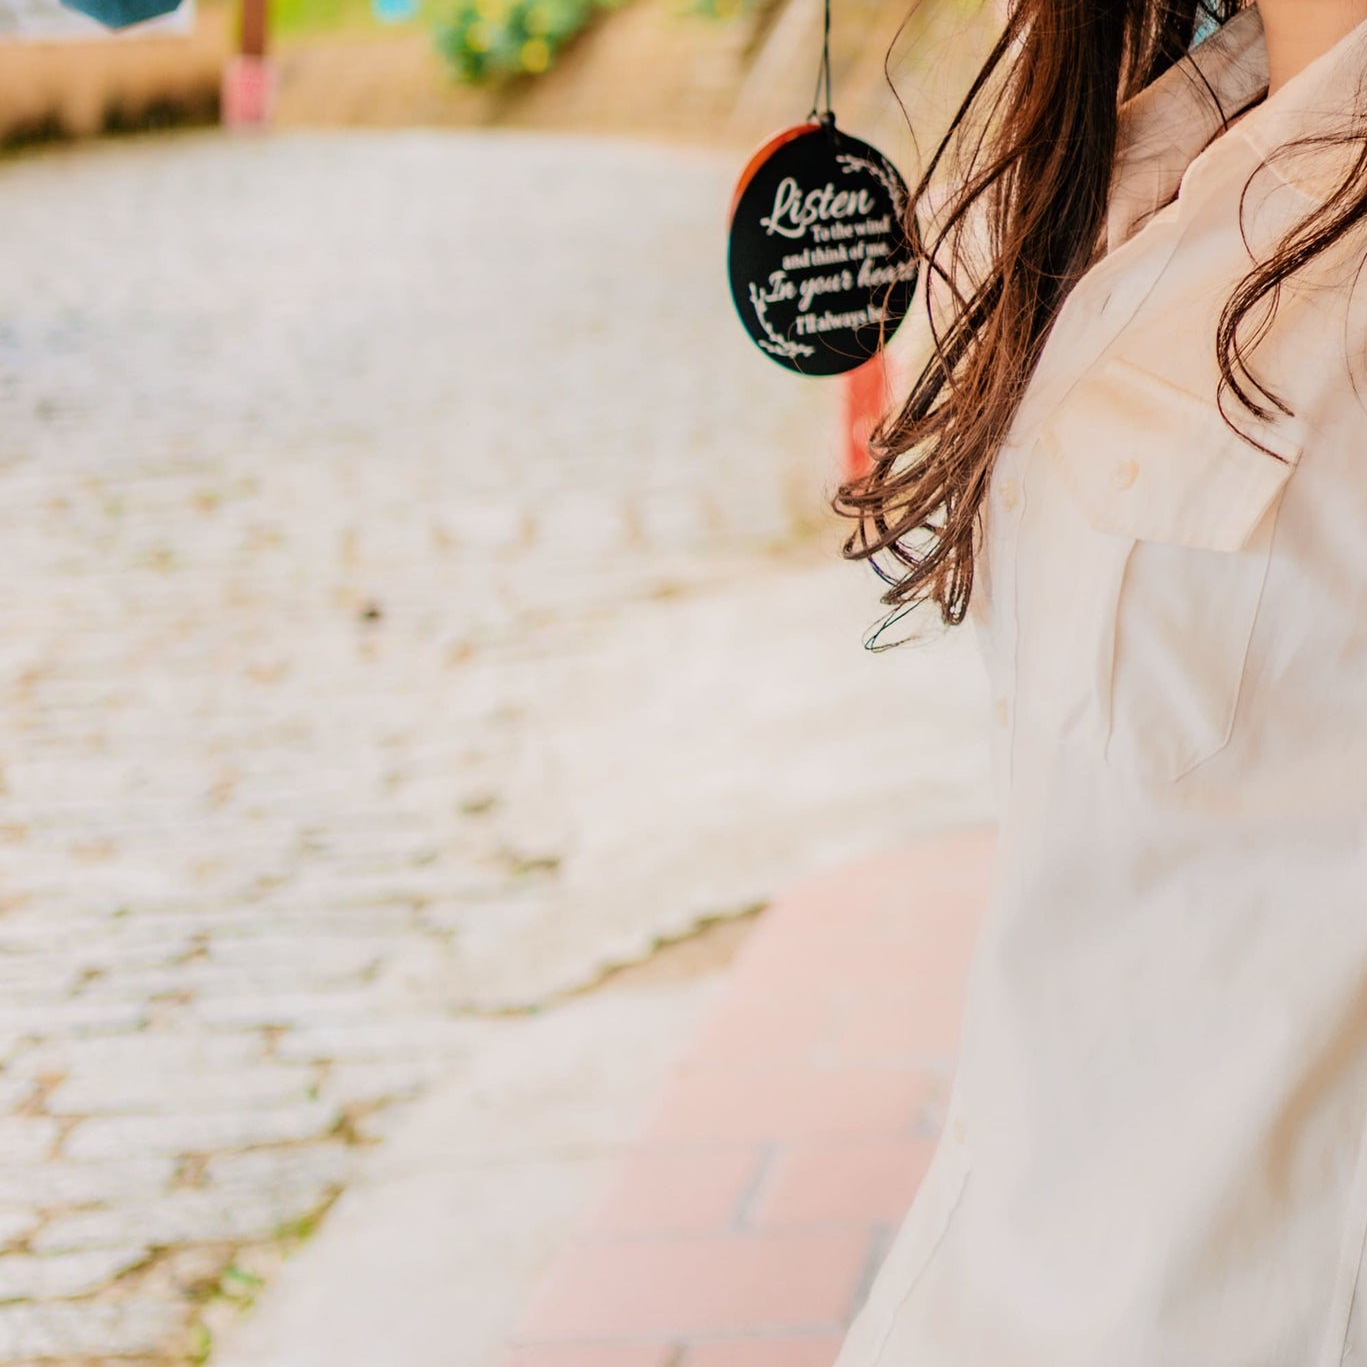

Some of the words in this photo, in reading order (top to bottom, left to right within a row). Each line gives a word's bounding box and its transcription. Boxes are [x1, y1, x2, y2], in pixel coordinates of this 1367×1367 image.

[760, 176, 875, 238] Listen
[809, 224, 830, 243] To
[830, 220, 853, 240] the
[854, 214, 890, 236] wind
[783, 247, 811, 271] and
[811, 243, 848, 266] think
[848, 240, 865, 260] of
[766, 270, 797, 303] In
[799, 269, 853, 313] your
[817, 309, 868, 332] always
